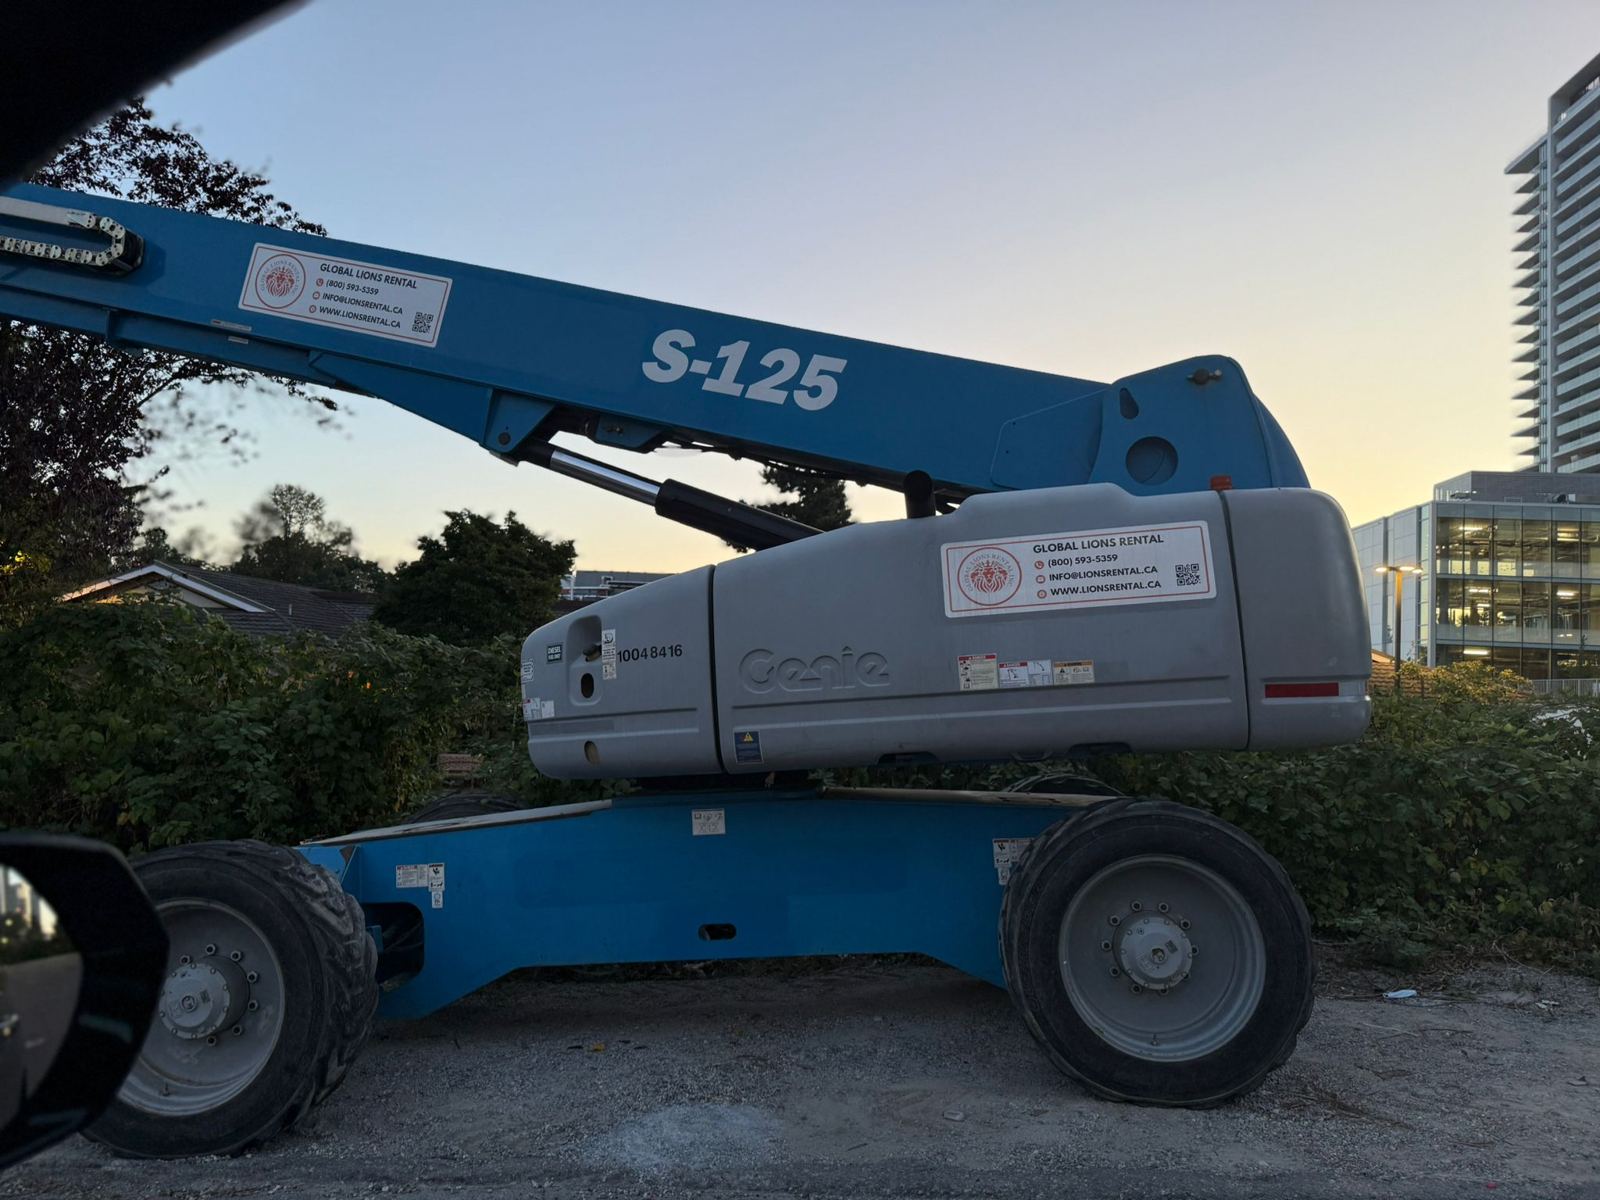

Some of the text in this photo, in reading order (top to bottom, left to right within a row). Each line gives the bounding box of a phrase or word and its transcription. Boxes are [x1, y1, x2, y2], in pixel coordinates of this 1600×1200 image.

[320, 263, 417, 289] GLOBAL LIONS RENTAL
[326, 279, 379, 296] (800) 593-5359
[322, 292, 403, 315] INFO@LIONSRENTAL.CA
[319, 305, 401, 329] WWW.LIONSRENTAL.CA
[642, 329, 848, 411] S-125
[1033, 534, 1164, 554] GLOBAL LIONS RENTAL
[1048, 553, 1118, 569] (800) 593-5359
[1049, 565, 1158, 582] INFO@LIONSRENTAL.CA
[1050, 580, 1161, 597] WWW.LIONSRENTAL.CA
[617, 644, 683, 663] 10048416
[739, 645, 890, 694] Genie
